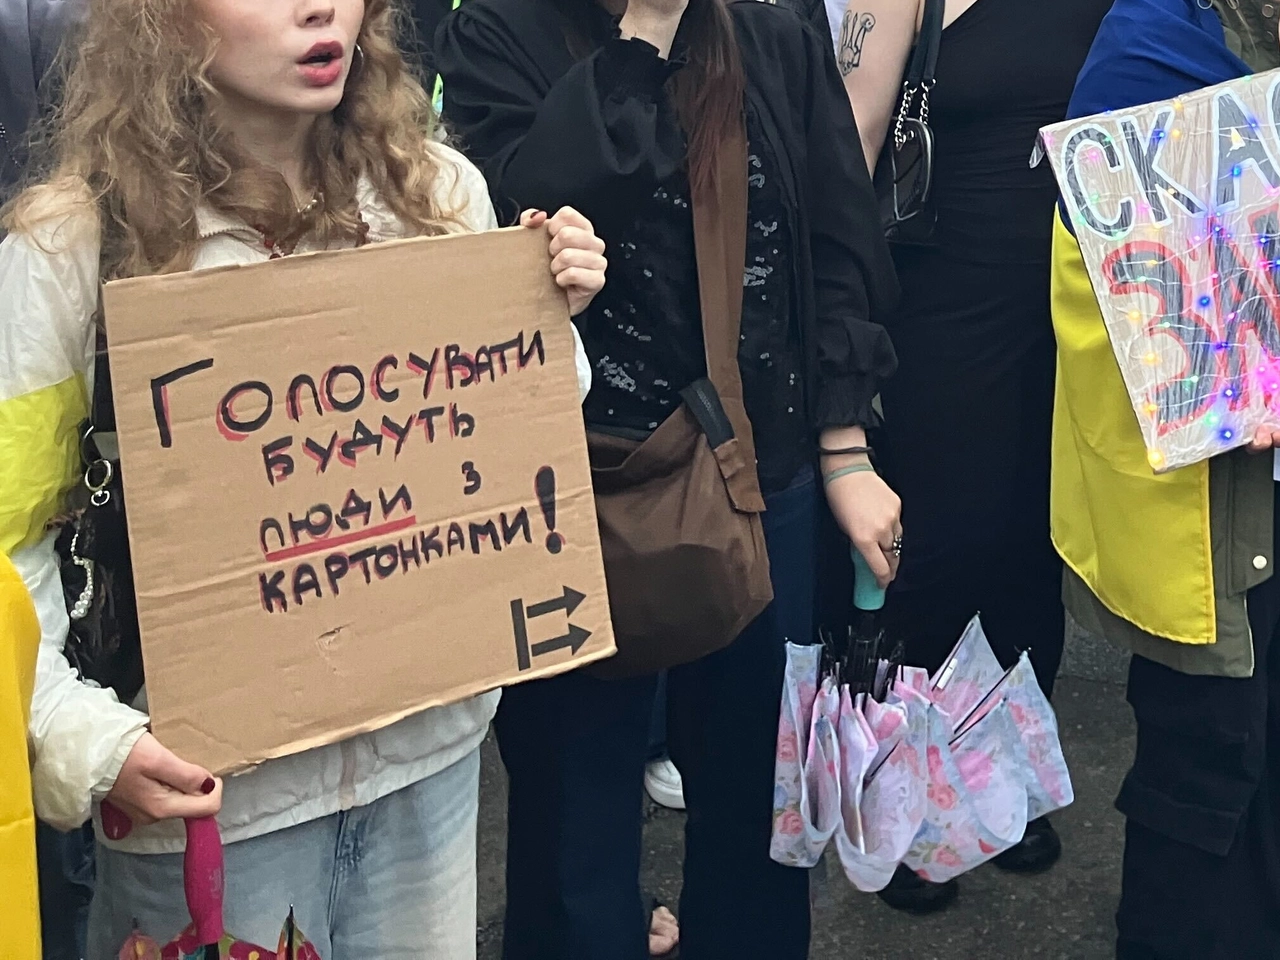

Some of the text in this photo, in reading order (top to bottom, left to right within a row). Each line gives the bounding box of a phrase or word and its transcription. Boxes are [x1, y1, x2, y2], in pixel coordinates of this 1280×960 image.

[261, 403, 476, 487] БУДУТЬ
[257, 465, 567, 613] КАРТОНКАМИ!
[259, 483, 413, 553] ЛЮДИ
